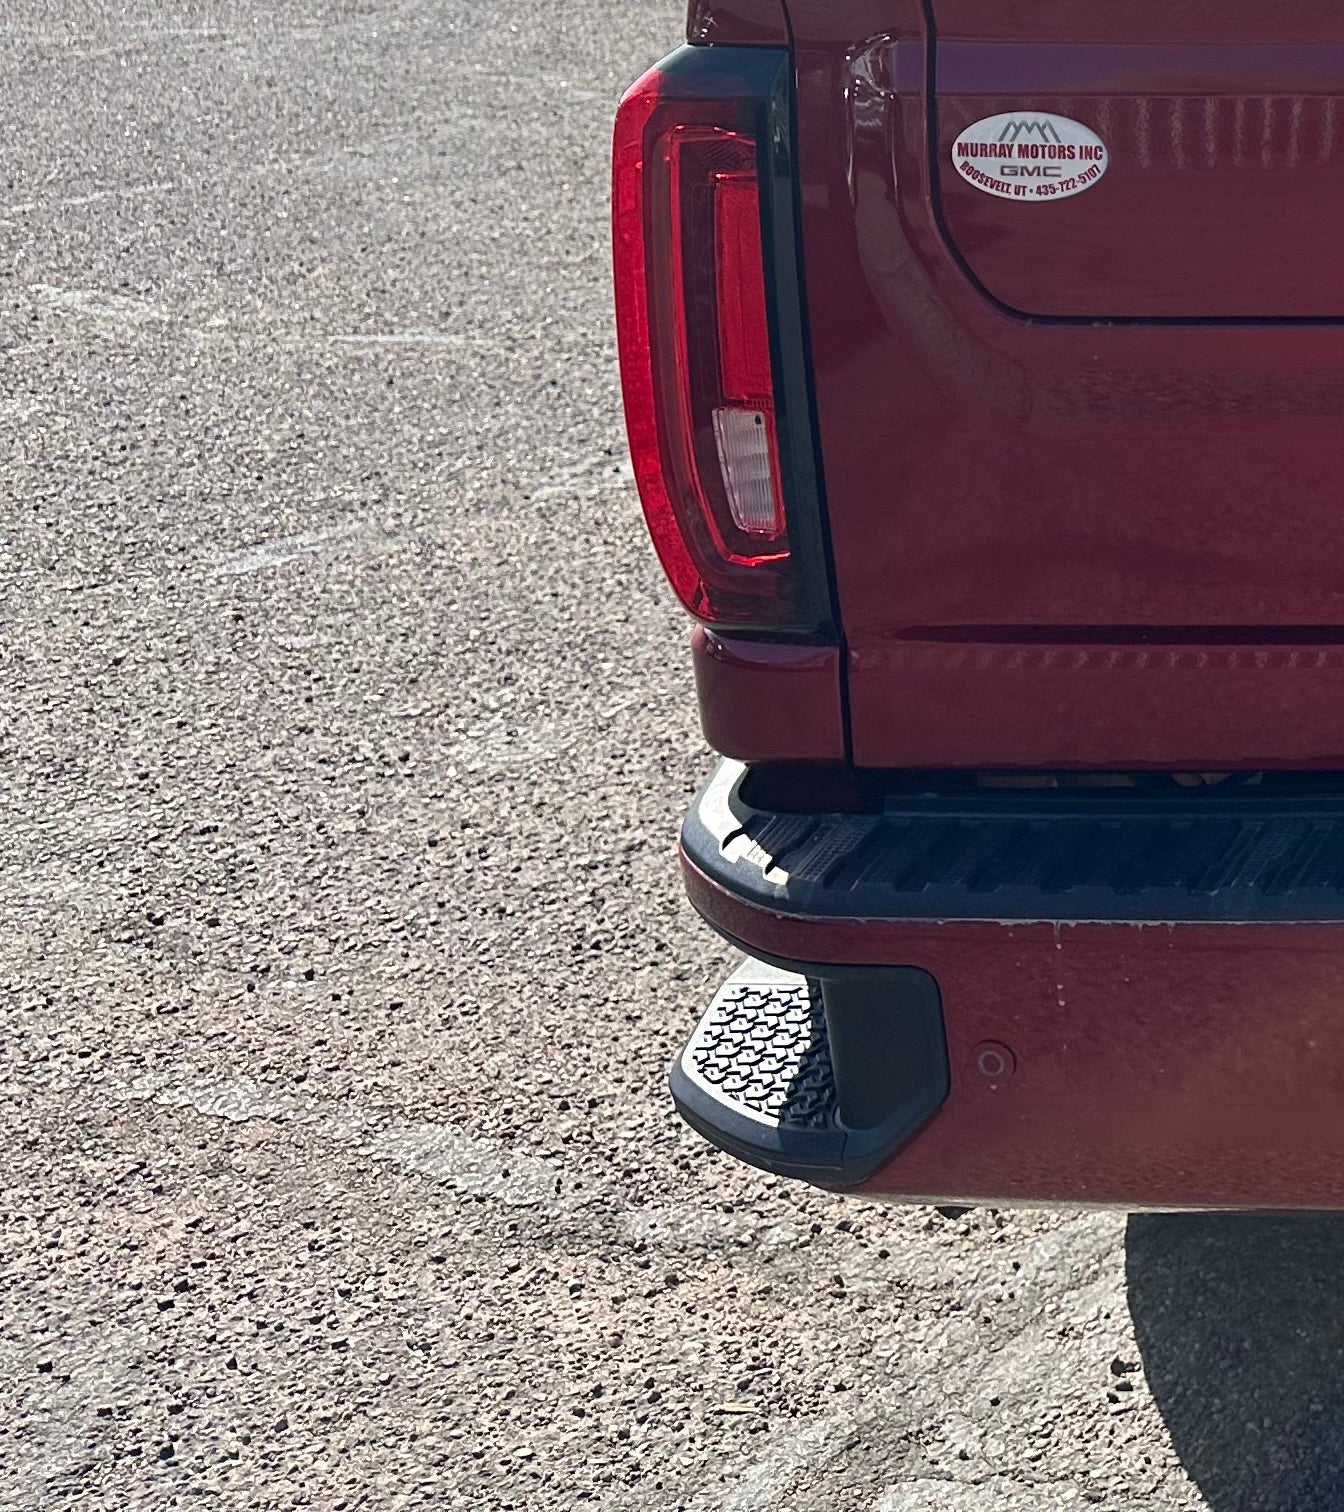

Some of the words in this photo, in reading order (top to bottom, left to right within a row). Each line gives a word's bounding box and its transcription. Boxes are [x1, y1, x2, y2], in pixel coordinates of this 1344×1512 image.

[957, 142, 1015, 159] MURRAY
[1018, 144, 1076, 160] MOTORS
[1079, 145, 1103, 161] INC
[1000, 165, 1063, 178] GMC
[1014, 184, 1026, 197] UT
